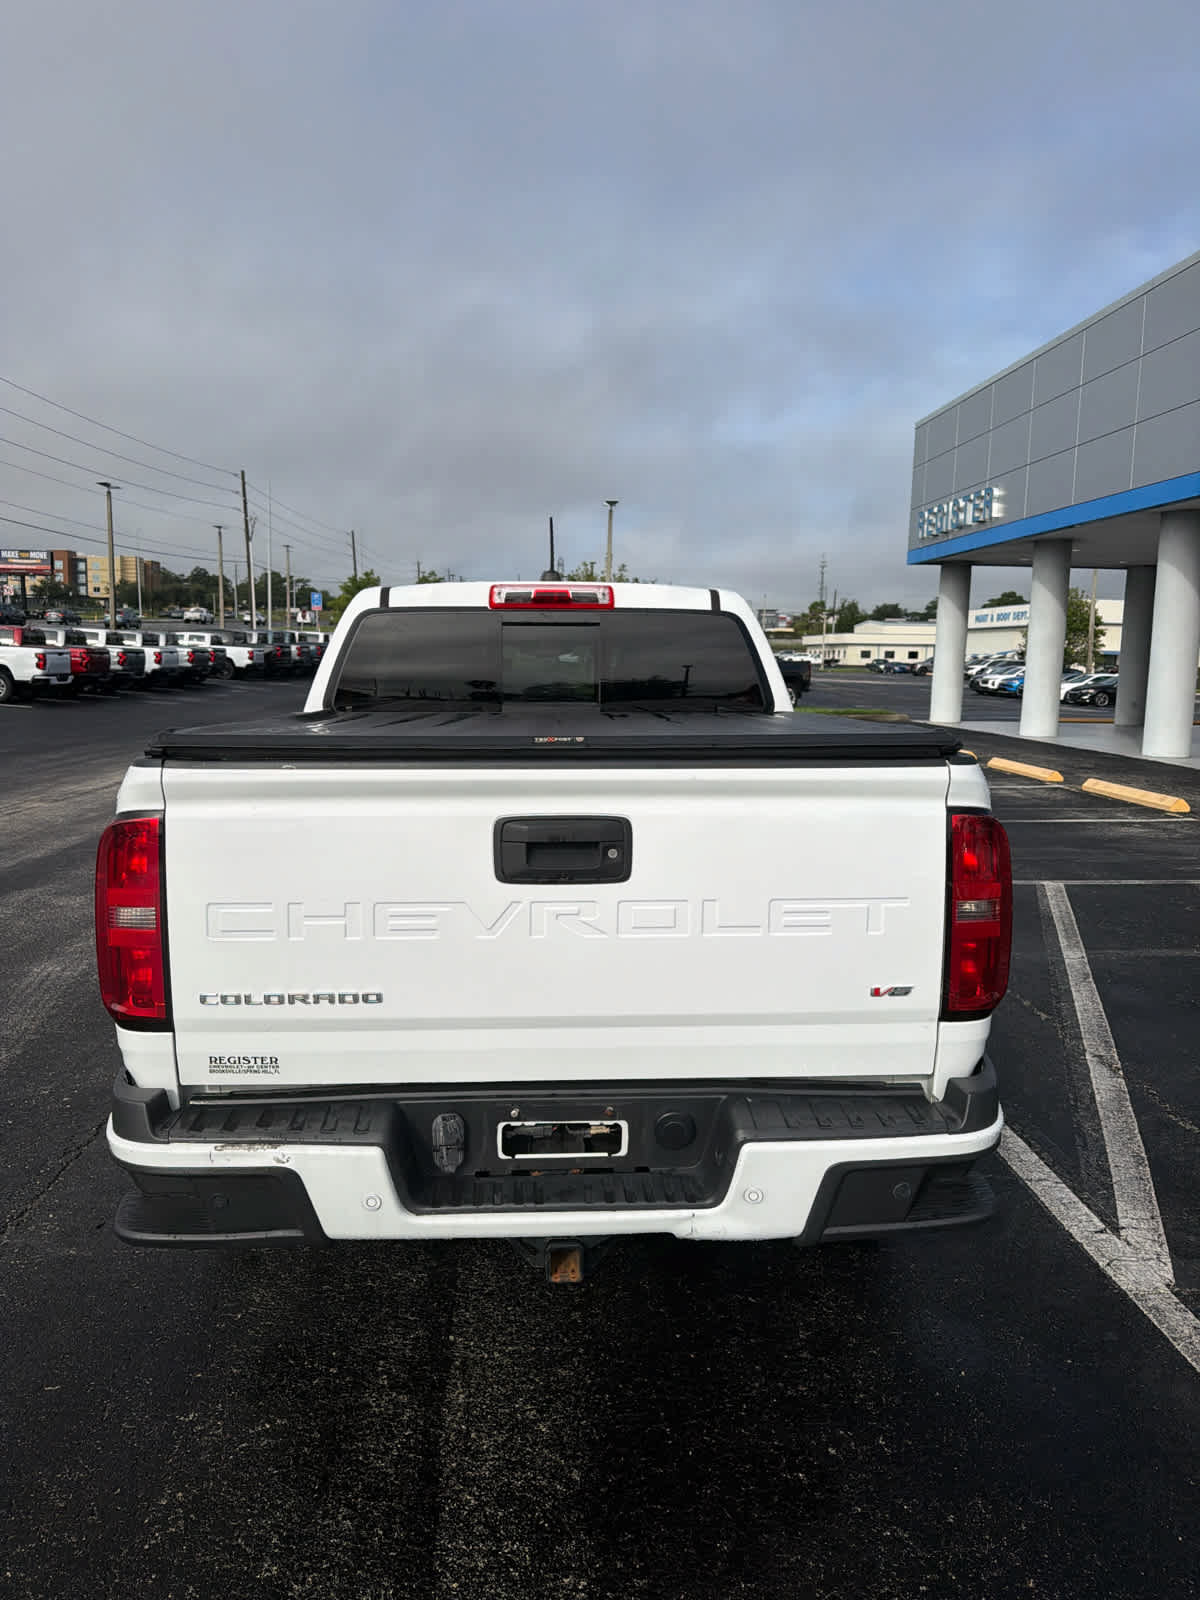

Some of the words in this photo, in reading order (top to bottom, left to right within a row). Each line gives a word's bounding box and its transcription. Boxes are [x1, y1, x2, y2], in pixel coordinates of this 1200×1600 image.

[918, 487, 994, 538] REGISTER
[206, 897, 910, 941] CHEVROLET
[199, 992, 384, 1006] COLORADO
[208, 1056, 279, 1065] REGISTER
